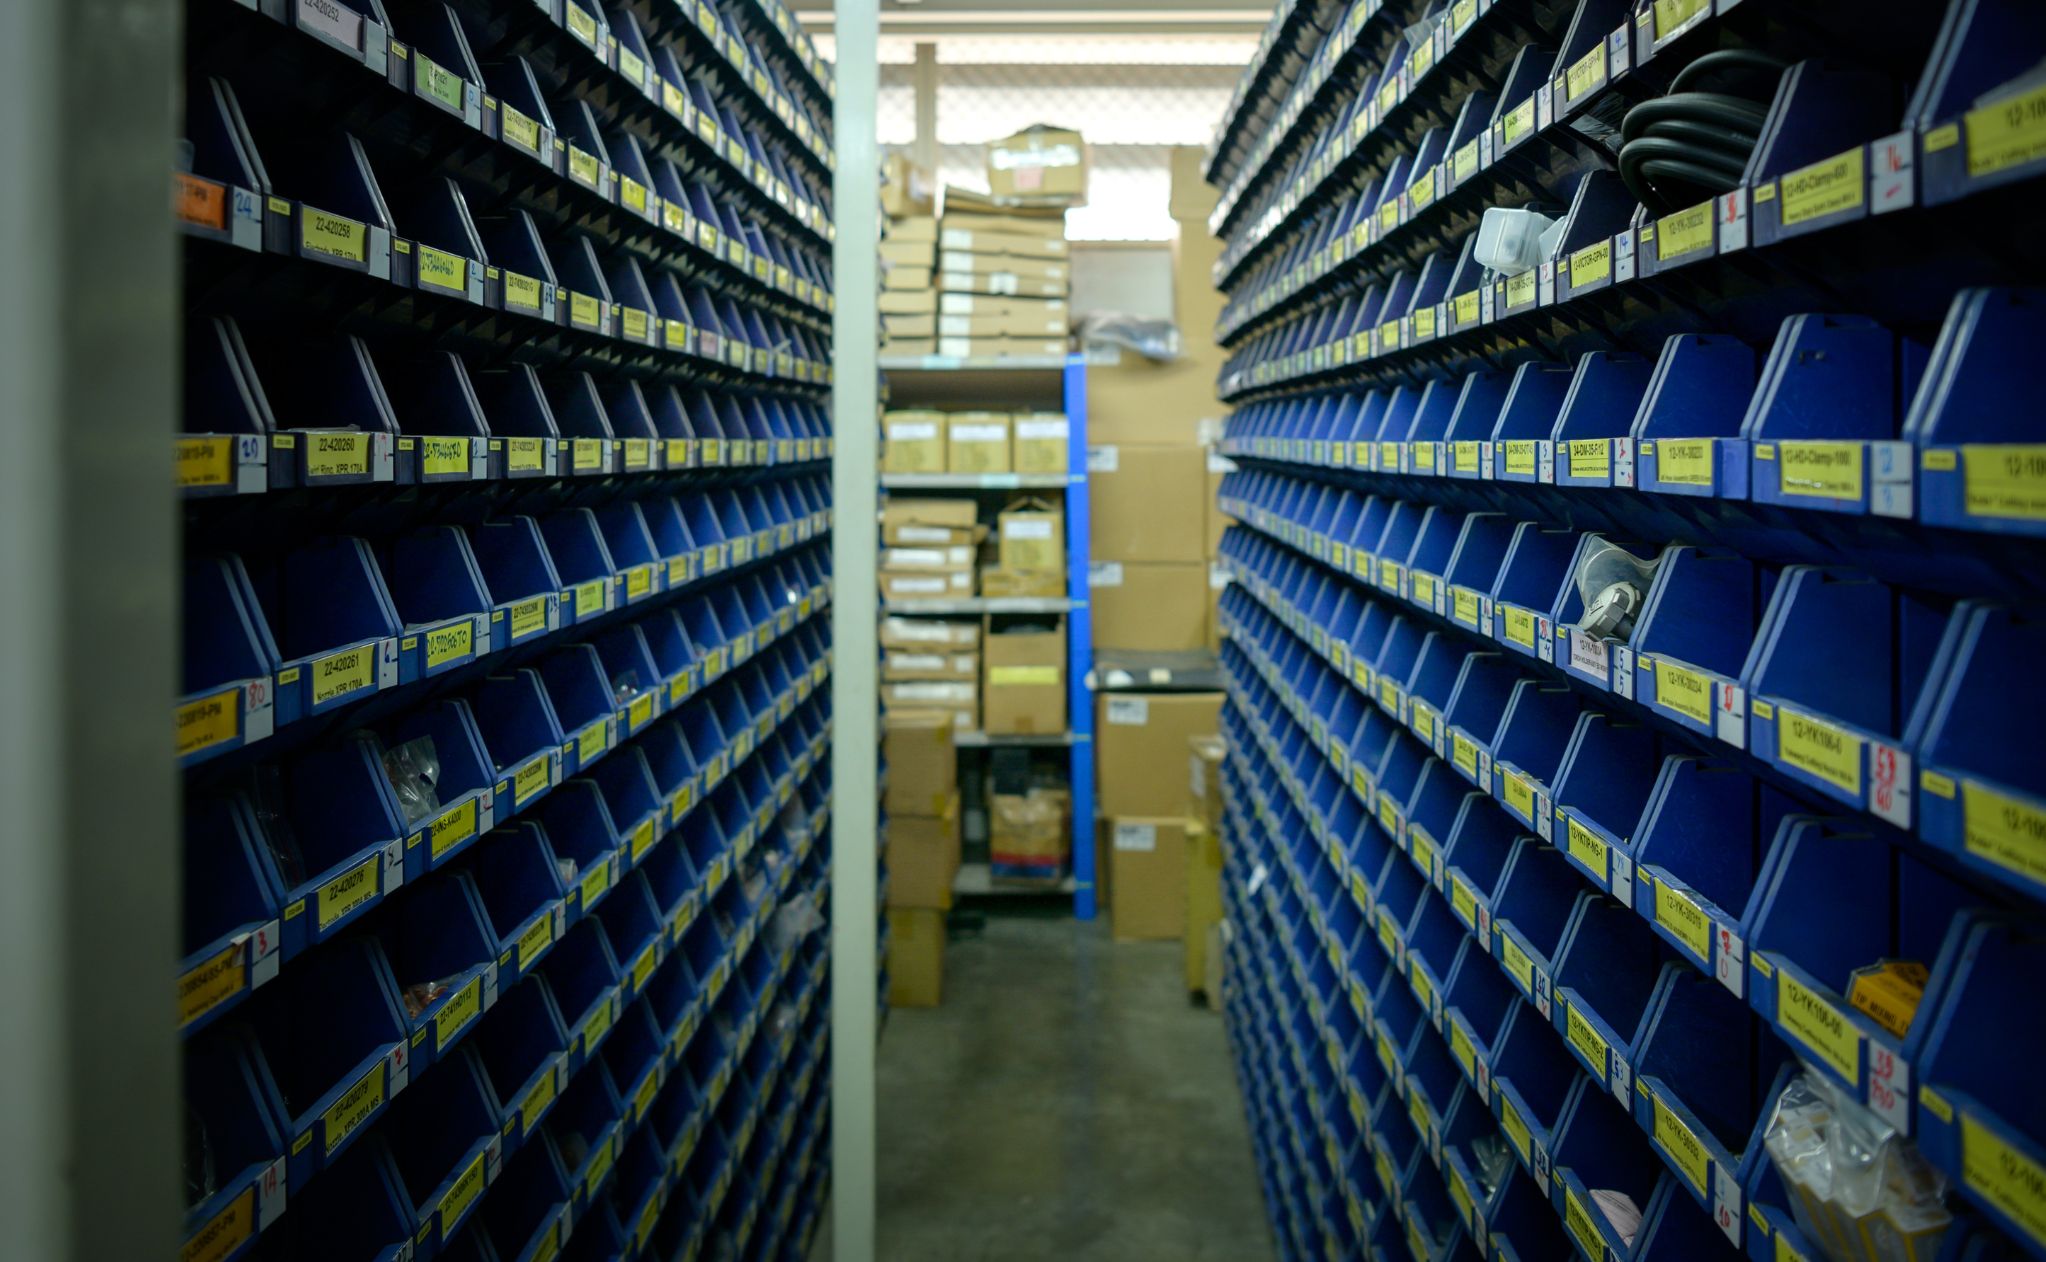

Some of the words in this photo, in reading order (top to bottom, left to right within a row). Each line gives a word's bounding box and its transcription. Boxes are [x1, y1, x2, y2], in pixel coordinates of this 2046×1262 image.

[315, 215, 351, 239] 22-420258
[319, 437, 355, 453] 22-420260
[323, 653, 359, 678] 22-420261
[328, 869, 365, 902] 22-420276
